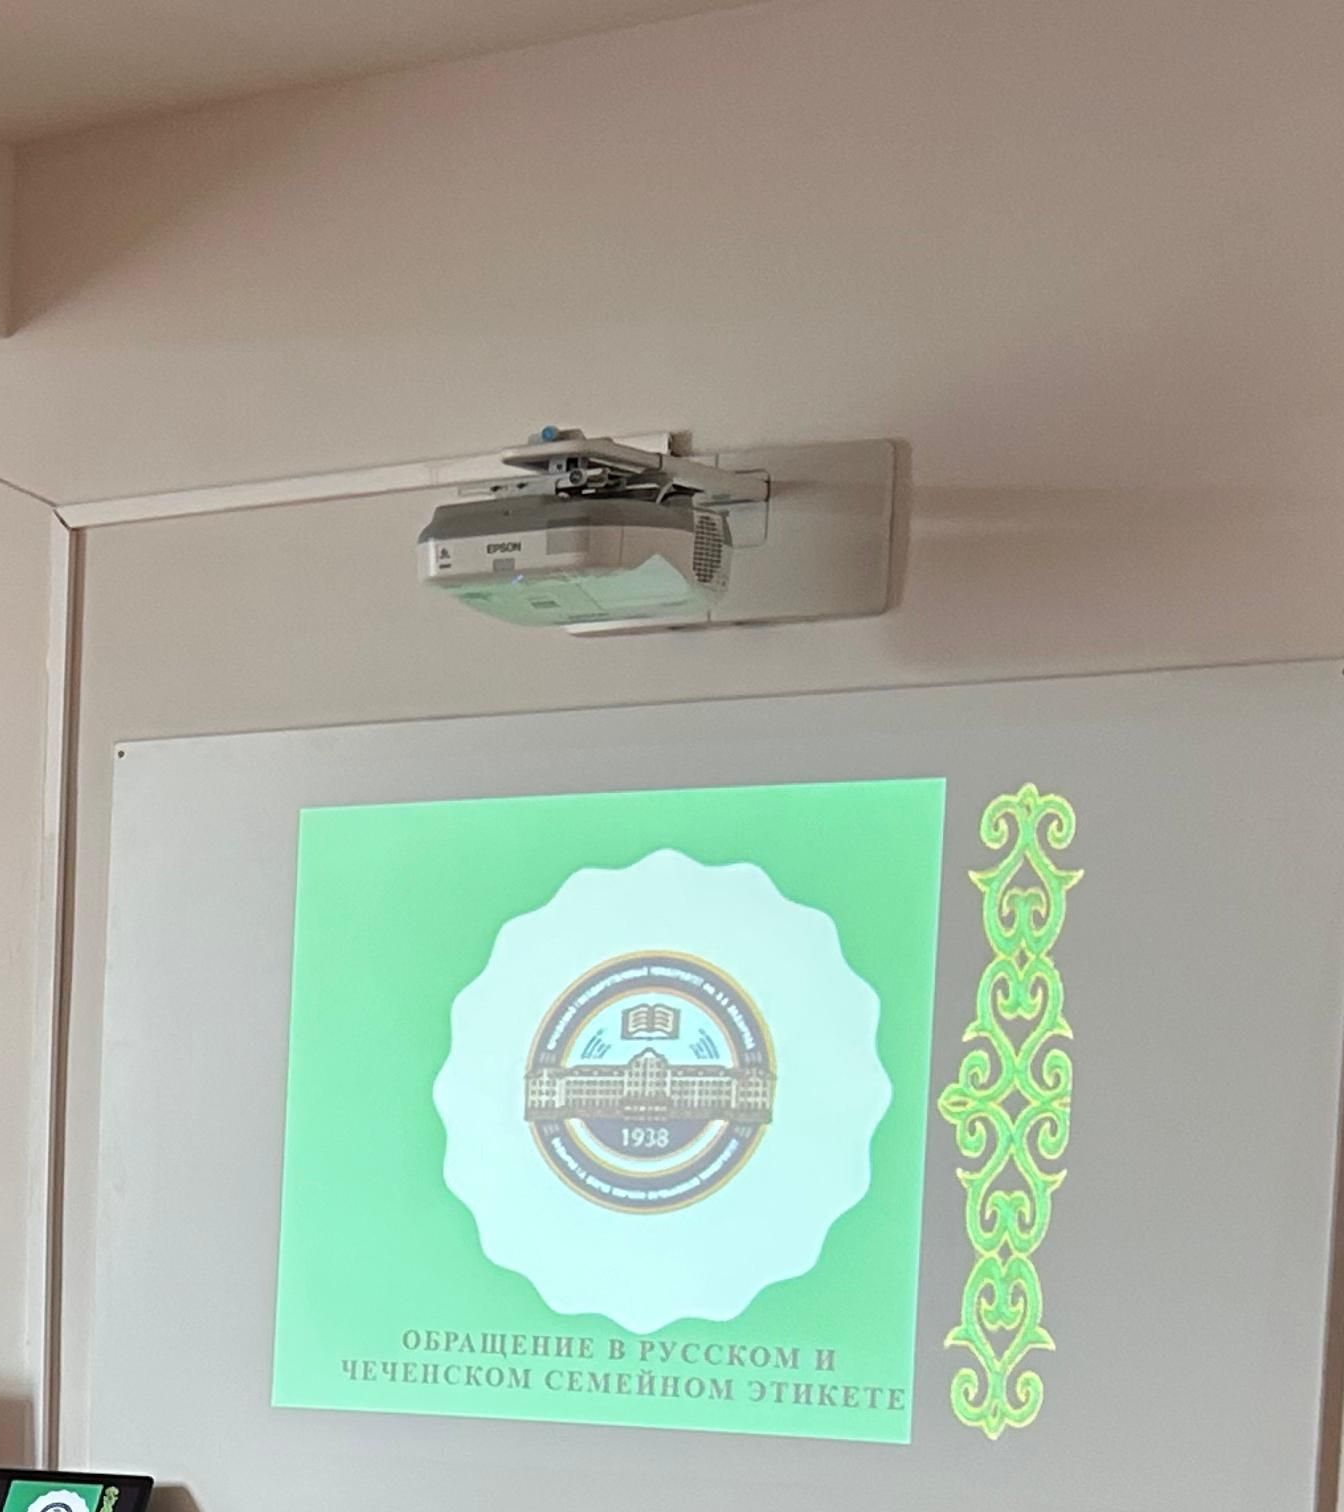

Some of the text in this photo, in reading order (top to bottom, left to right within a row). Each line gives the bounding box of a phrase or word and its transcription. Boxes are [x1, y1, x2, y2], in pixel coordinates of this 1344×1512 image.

[486, 542, 522, 554] EPSON
[621, 1128, 670, 1148] 1938
[402, 1329, 836, 1372] ОБРАЩЕНИЕ В РУССКОМ И
[341, 1359, 905, 1411] ЧЕЧЕНСКОМ СЕМЕЙНОМ ЭТИКЕТЕ
